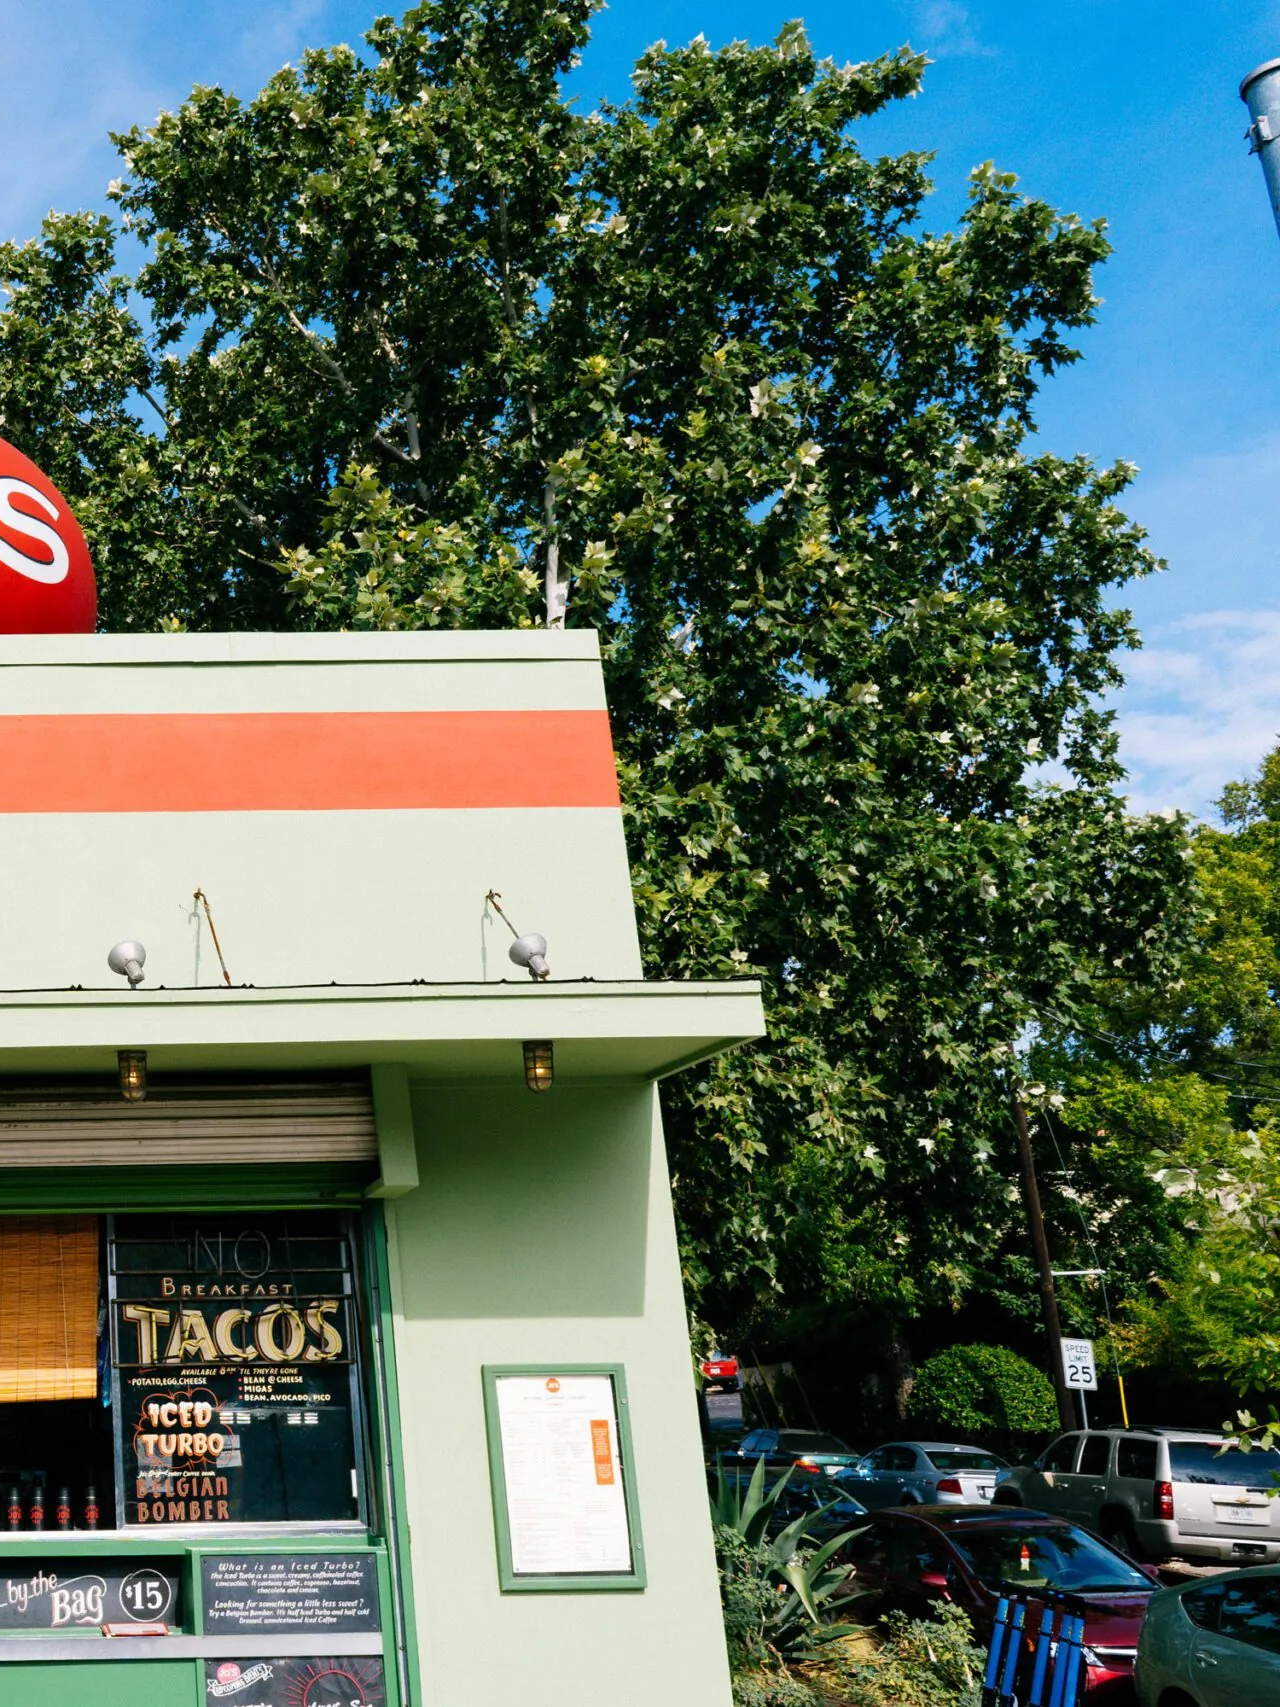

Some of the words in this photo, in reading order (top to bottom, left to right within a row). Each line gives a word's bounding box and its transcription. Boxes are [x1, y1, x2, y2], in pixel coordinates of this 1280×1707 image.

[194, 1229, 271, 1279] NO
[161, 1277, 293, 1297] BREAKFAST
[122, 1300, 343, 1364] TACOS
[1065, 1344, 1090, 1354] SPEED
[1069, 1354, 1088, 1364] LIMIT
[181, 1368, 217, 1376] AVAILABLE
[280, 1367, 298, 1375] GONE
[1068, 1364, 1093, 1384] 25
[243, 1376, 265, 1384] BEAN
[244, 1385, 273, 1393] MIGAS
[313, 1393, 331, 1401] PICO
[148, 1401, 212, 1428] ICED
[141, 1433, 224, 1458] TURBO
[136, 1477, 228, 1498] BELGIAN
[138, 1500, 229, 1522] BOMBER
[219, 1562, 247, 1571] What
[255, 1562, 264, 1571] is
[291, 1562, 318, 1571] Iced
[6, 1579, 30, 1611] by
[30, 1570, 58, 1599] the
[51, 1576, 107, 1627] Bag
[125, 1580, 163, 1610] $15
[215, 1599, 245, 1610] Looking
[246, 1599, 258, 1610] for
[304, 1599, 320, 1607] little
[322, 1599, 336, 1607] less
[209, 1609, 219, 1619] Try
[331, 1608, 343, 1616] and
[344, 1608, 356, 1617] half
[318, 1616, 337, 1625] Coffee
